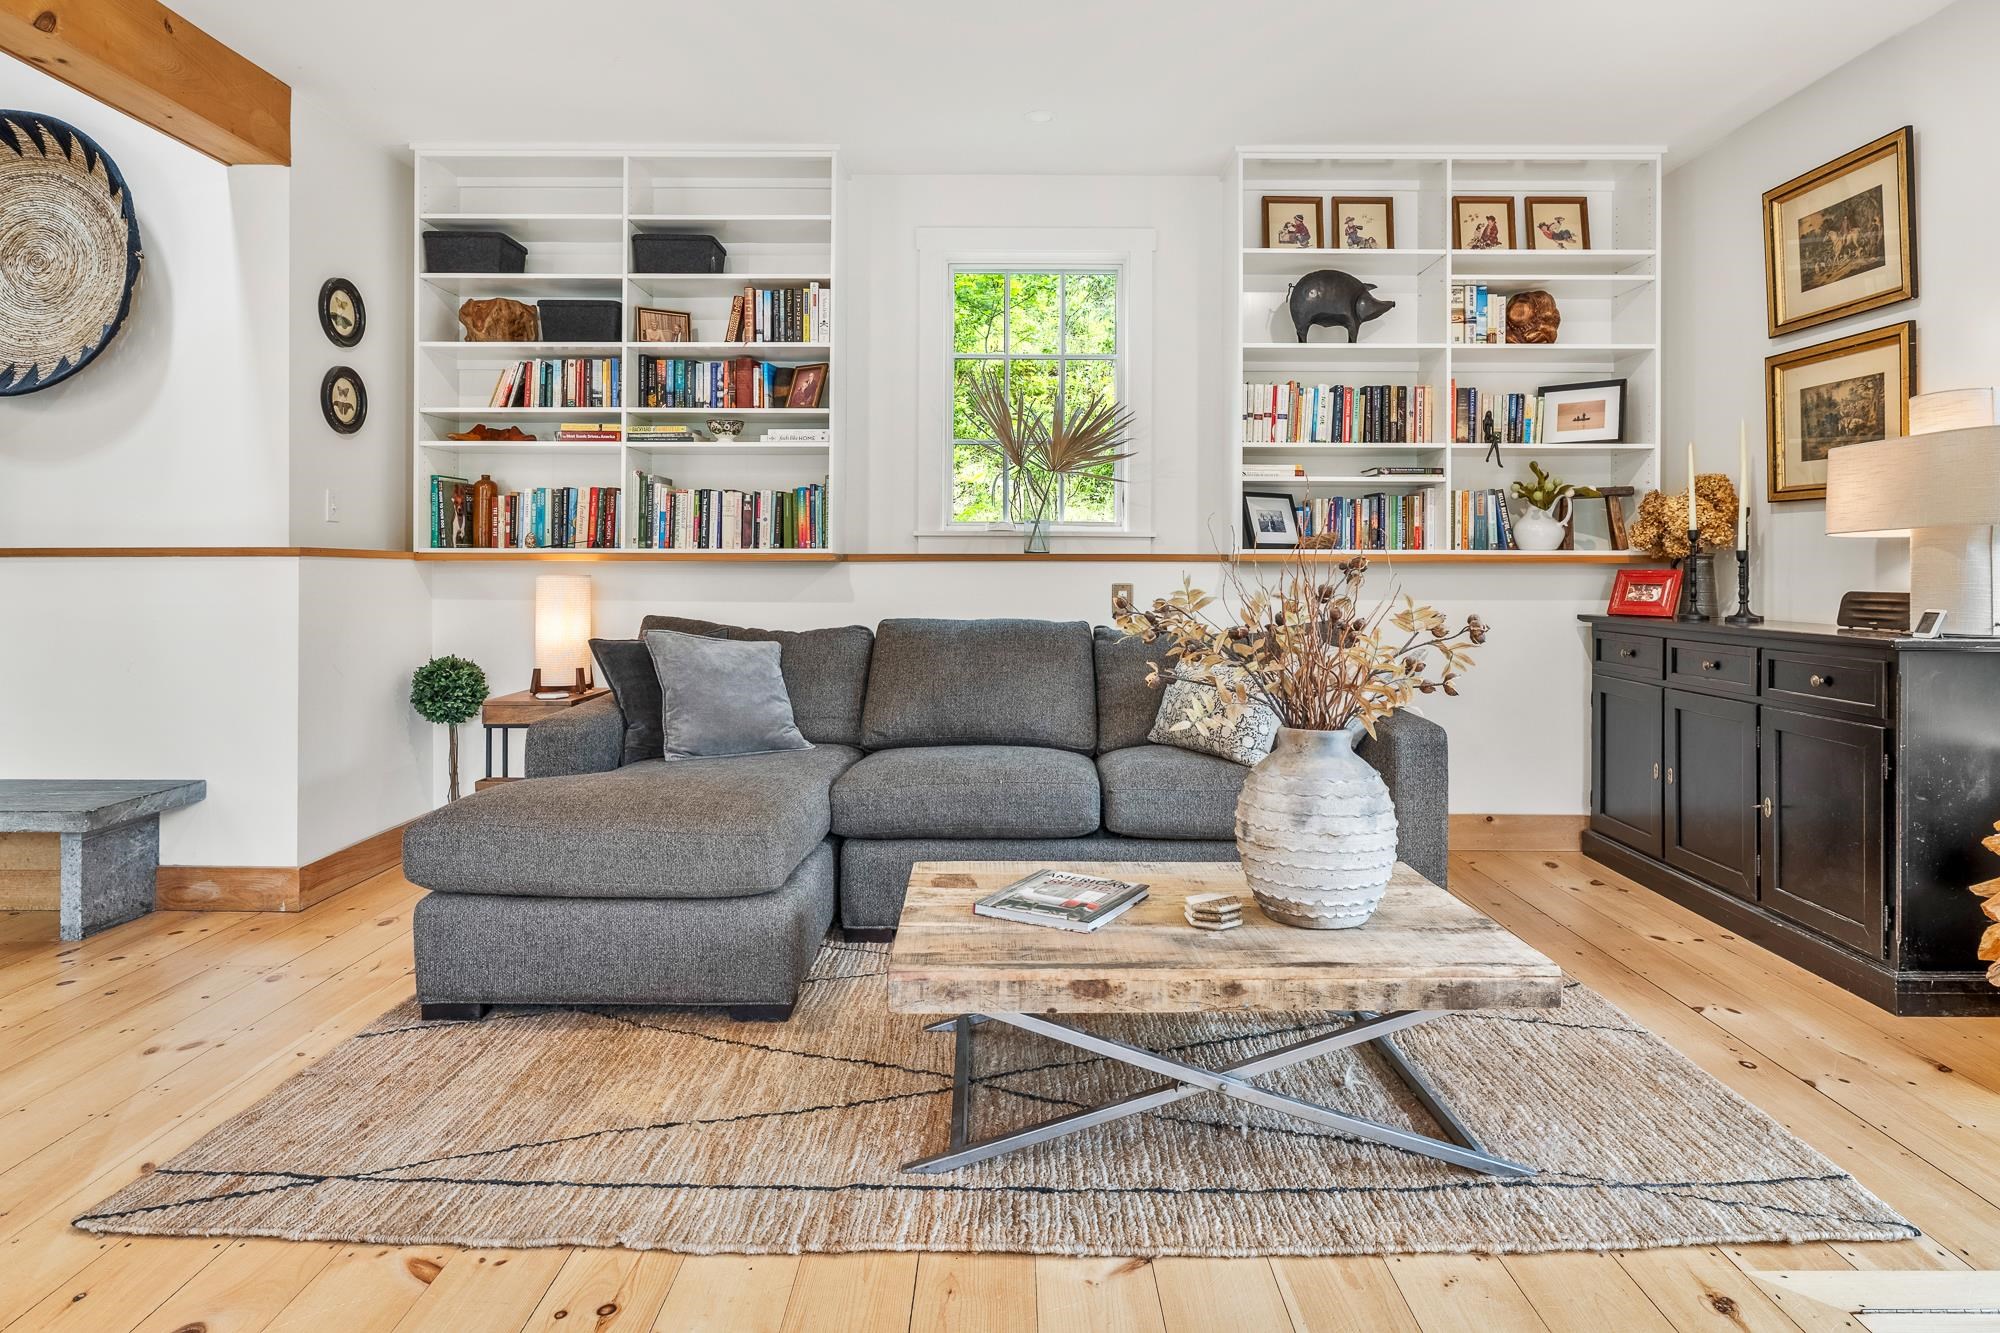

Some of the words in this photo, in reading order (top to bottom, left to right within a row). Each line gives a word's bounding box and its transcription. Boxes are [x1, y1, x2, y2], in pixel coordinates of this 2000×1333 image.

[1501, 507, 1510, 530] BEAUTIFUL
[1046, 873, 1131, 889] AMERICAN
[1047, 879, 1112, 892] RUSTIC
